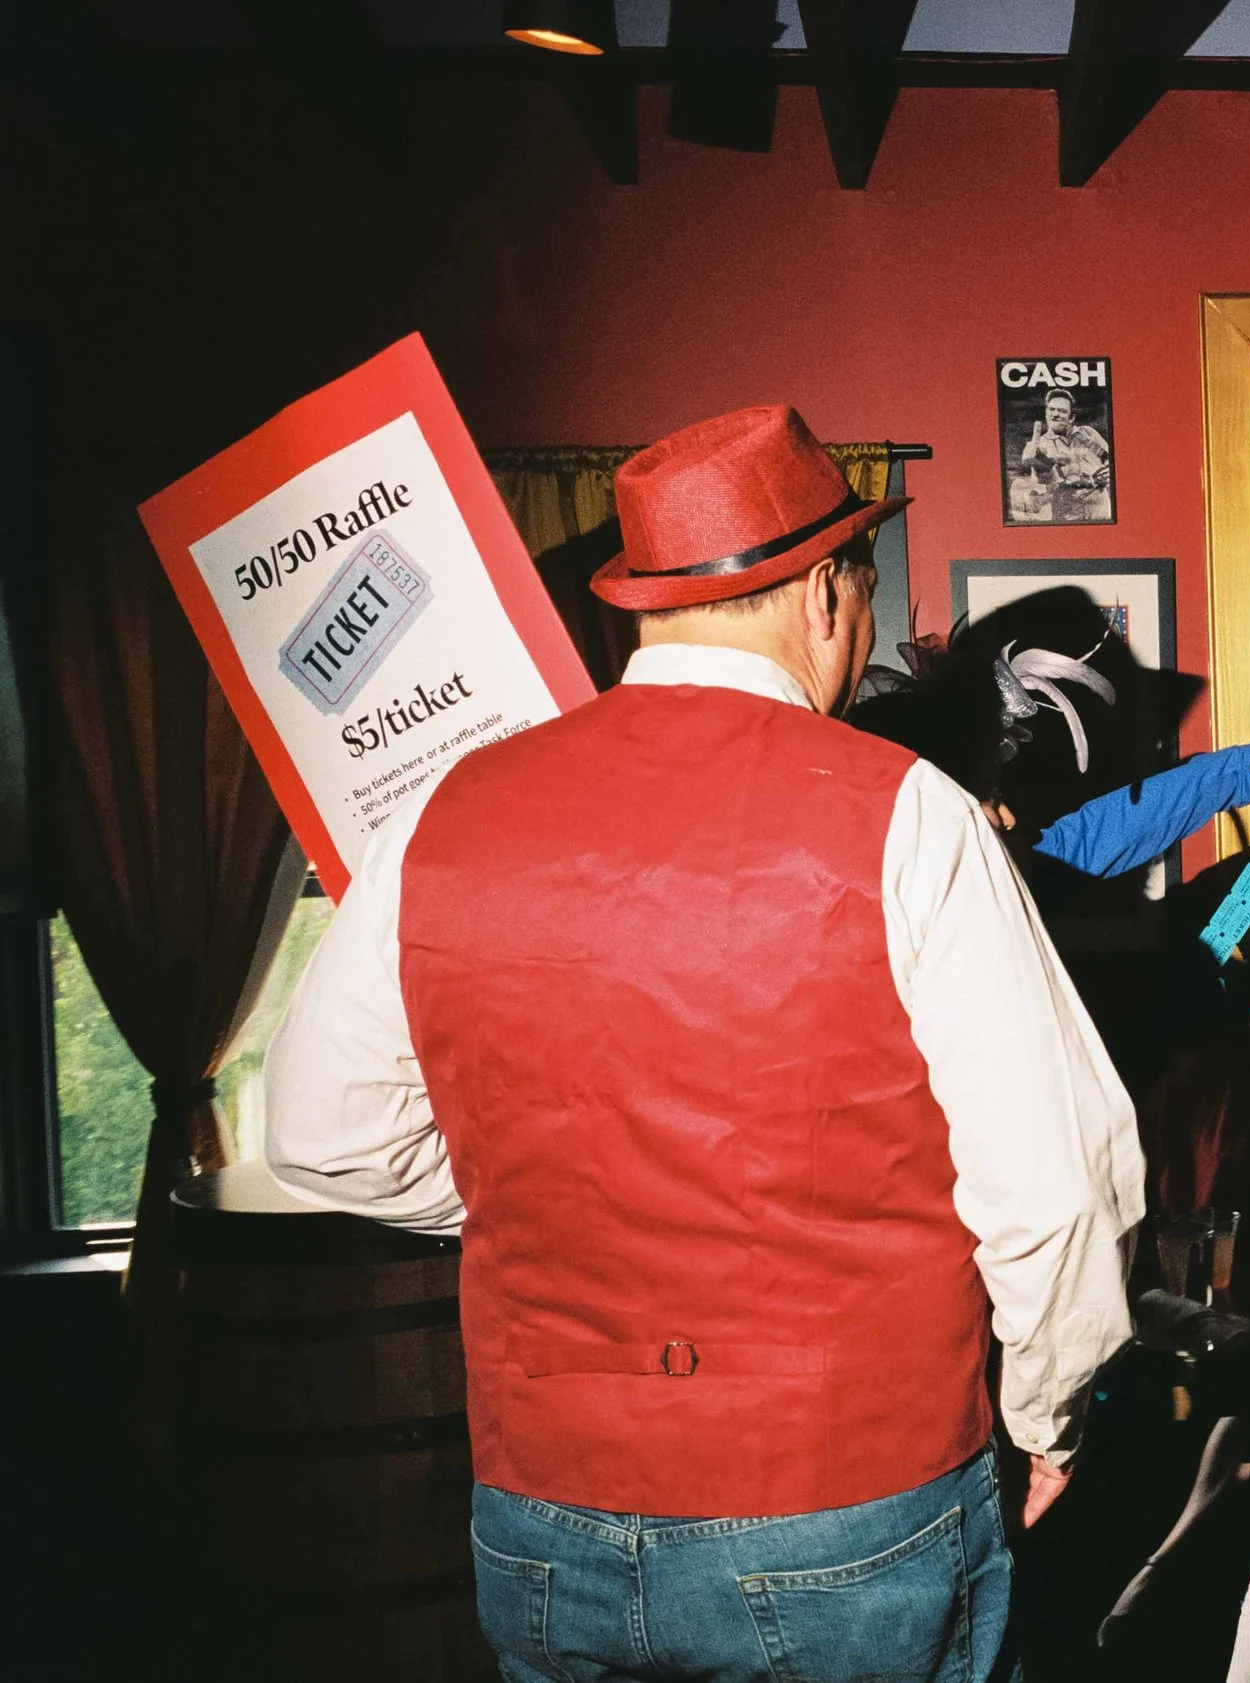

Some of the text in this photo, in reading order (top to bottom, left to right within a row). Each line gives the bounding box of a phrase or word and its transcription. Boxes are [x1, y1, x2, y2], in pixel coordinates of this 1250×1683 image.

[1000, 361, 1106, 388] CASH
[234, 480, 413, 601] 50/50 Raffle
[368, 543, 420, 594] 187537
[302, 574, 389, 682] TICKET
[341, 671, 474, 760] $5/ticket
[352, 784, 372, 800] Buy
[371, 767, 402, 790] tickets
[401, 757, 424, 775] here
[426, 748, 438, 760] or
[439, 741, 451, 754] at
[450, 728, 477, 750] raffle
[477, 713, 503, 733] table
[361, 797, 383, 816] 50%
[382, 791, 392, 804] of
[392, 784, 410, 803] pot
[503, 718, 532, 738] Force
